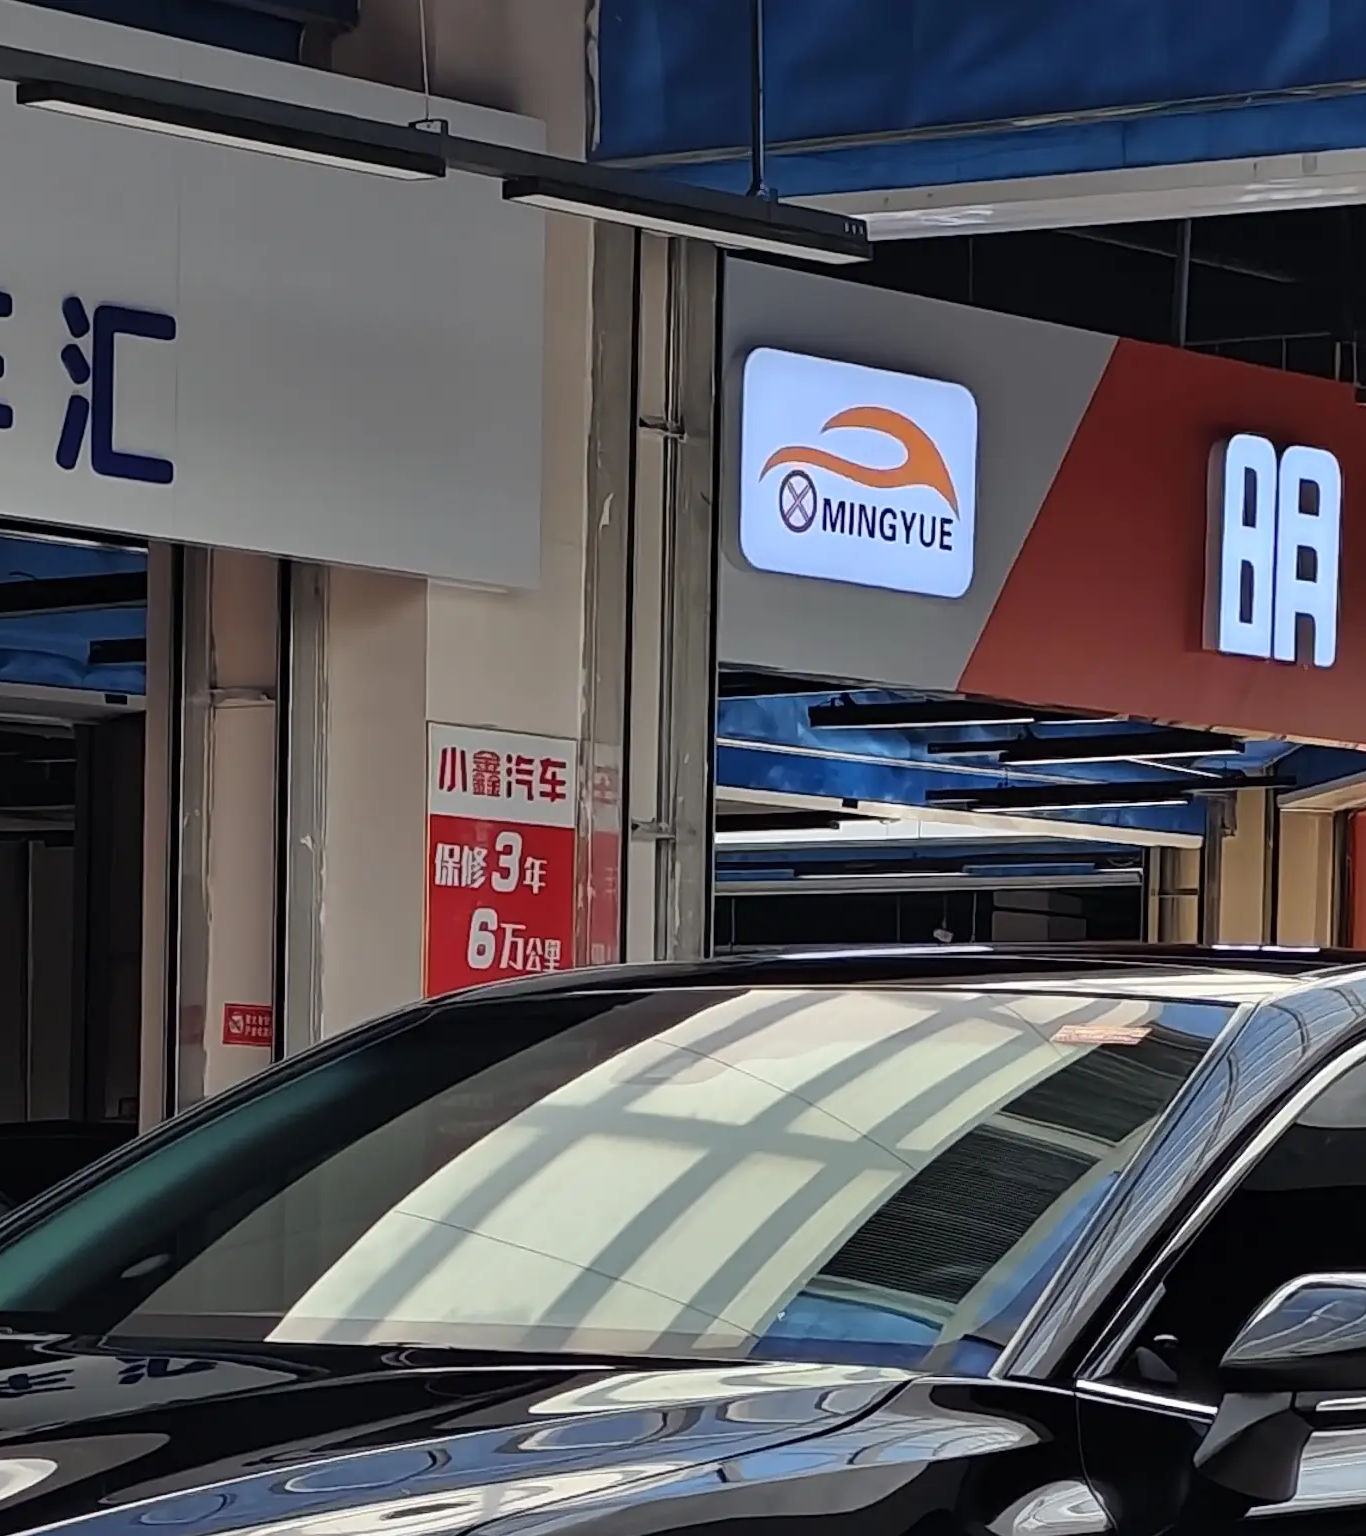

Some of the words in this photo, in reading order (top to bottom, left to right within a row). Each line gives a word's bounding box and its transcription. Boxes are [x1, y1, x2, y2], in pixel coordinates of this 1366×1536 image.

[821, 497, 954, 552] MINGYUE
[438, 746, 568, 802] 小鑫汽车
[434, 831, 549, 895] 保修3年
[467, 907, 562, 973] 6万公里
